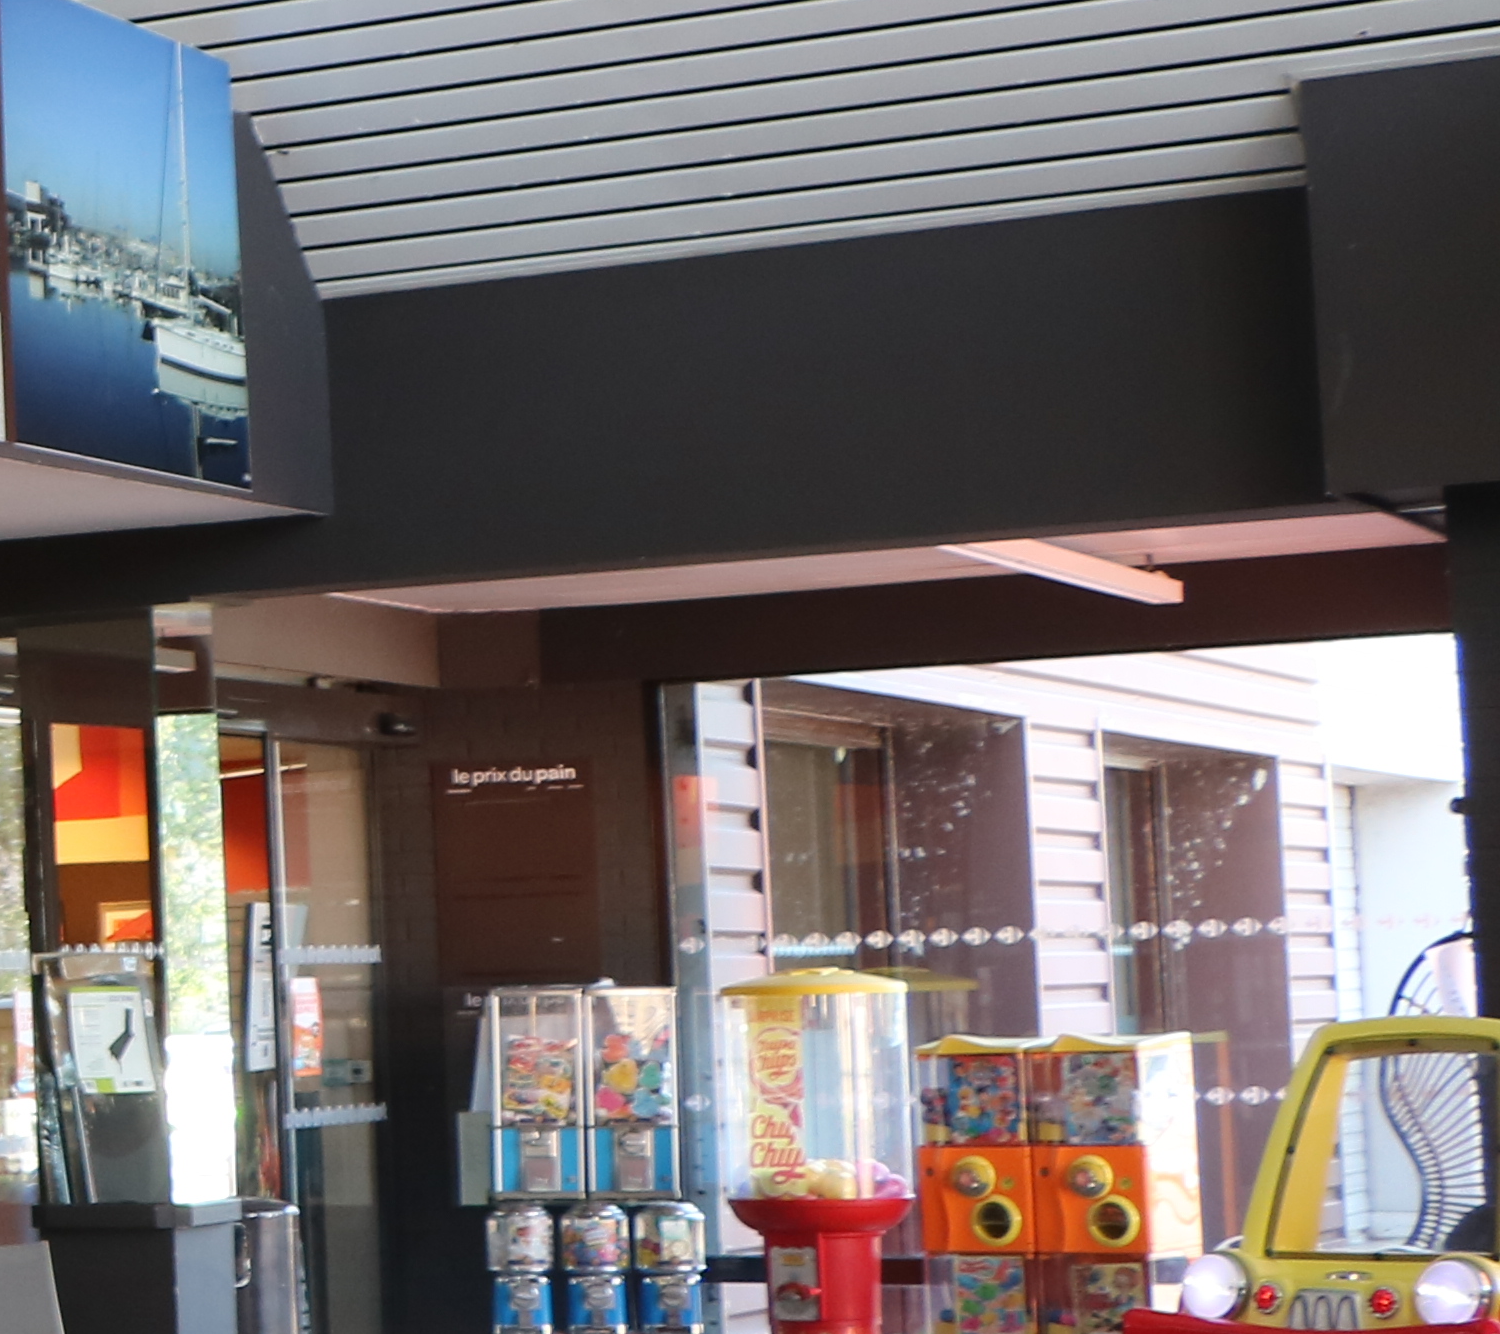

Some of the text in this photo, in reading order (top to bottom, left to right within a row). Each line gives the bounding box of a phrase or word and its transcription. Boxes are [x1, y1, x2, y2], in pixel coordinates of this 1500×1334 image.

[451, 763, 577, 787] le prix du pain
